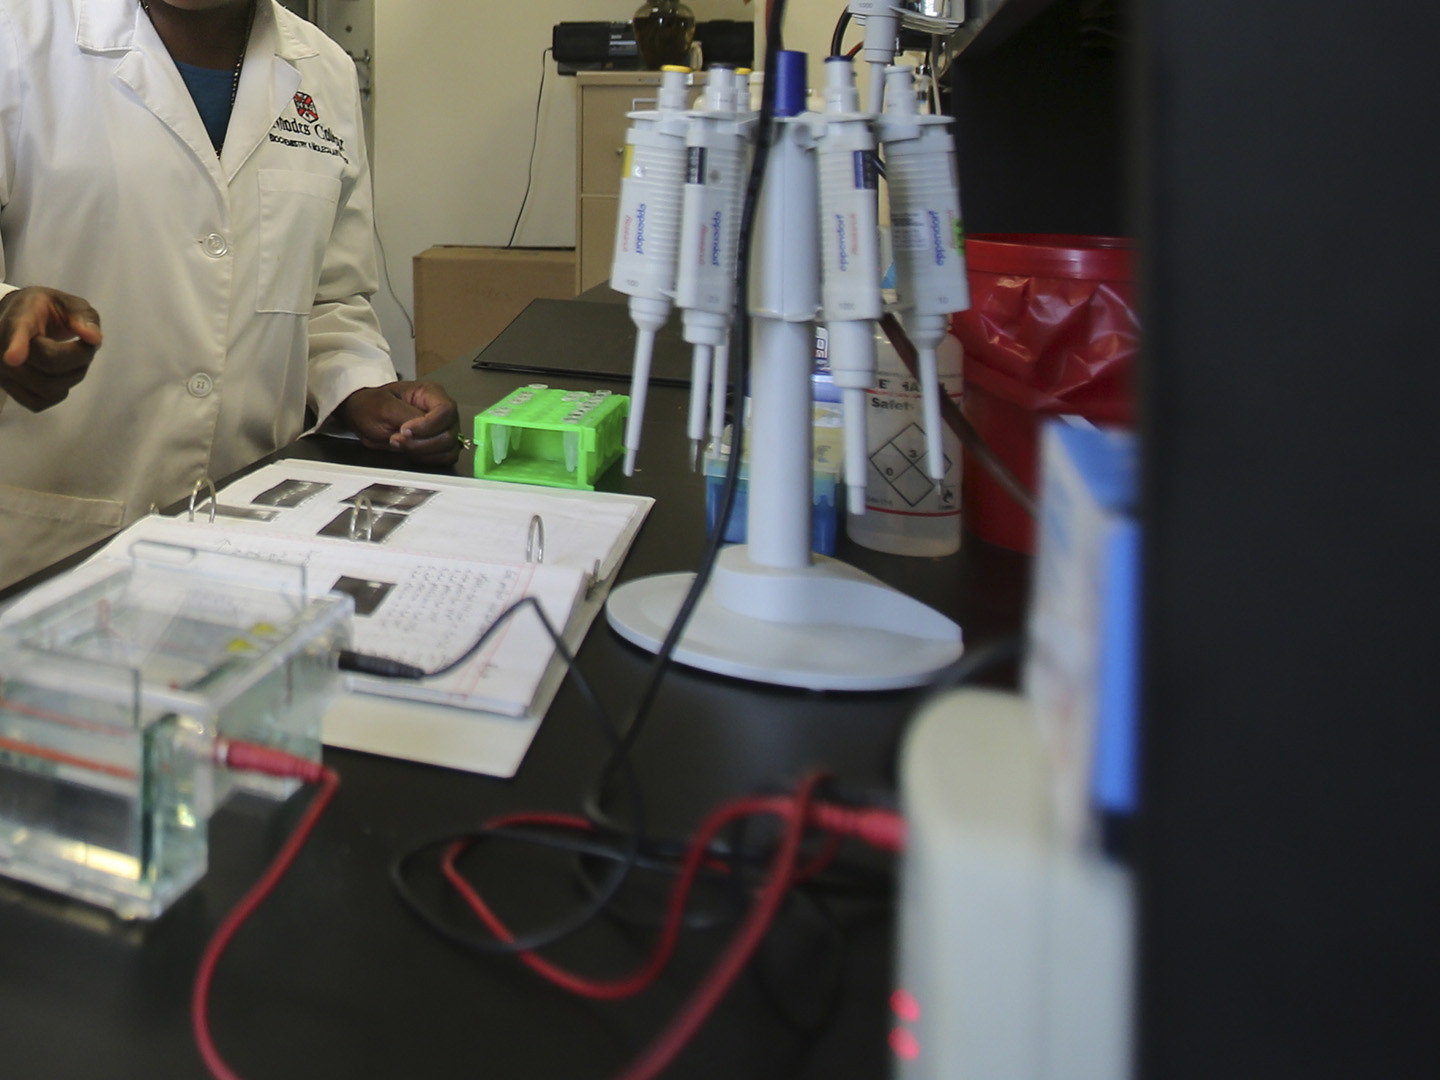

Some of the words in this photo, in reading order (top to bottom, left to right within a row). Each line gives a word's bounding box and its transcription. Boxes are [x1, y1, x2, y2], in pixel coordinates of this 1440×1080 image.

[635, 203, 646, 255] eppendorf
[712, 211, 722, 267] eppendorf
[836, 213, 850, 273] eppendorf
[928, 210, 946, 266] eppendorf
[909, 449, 918, 459] 3
